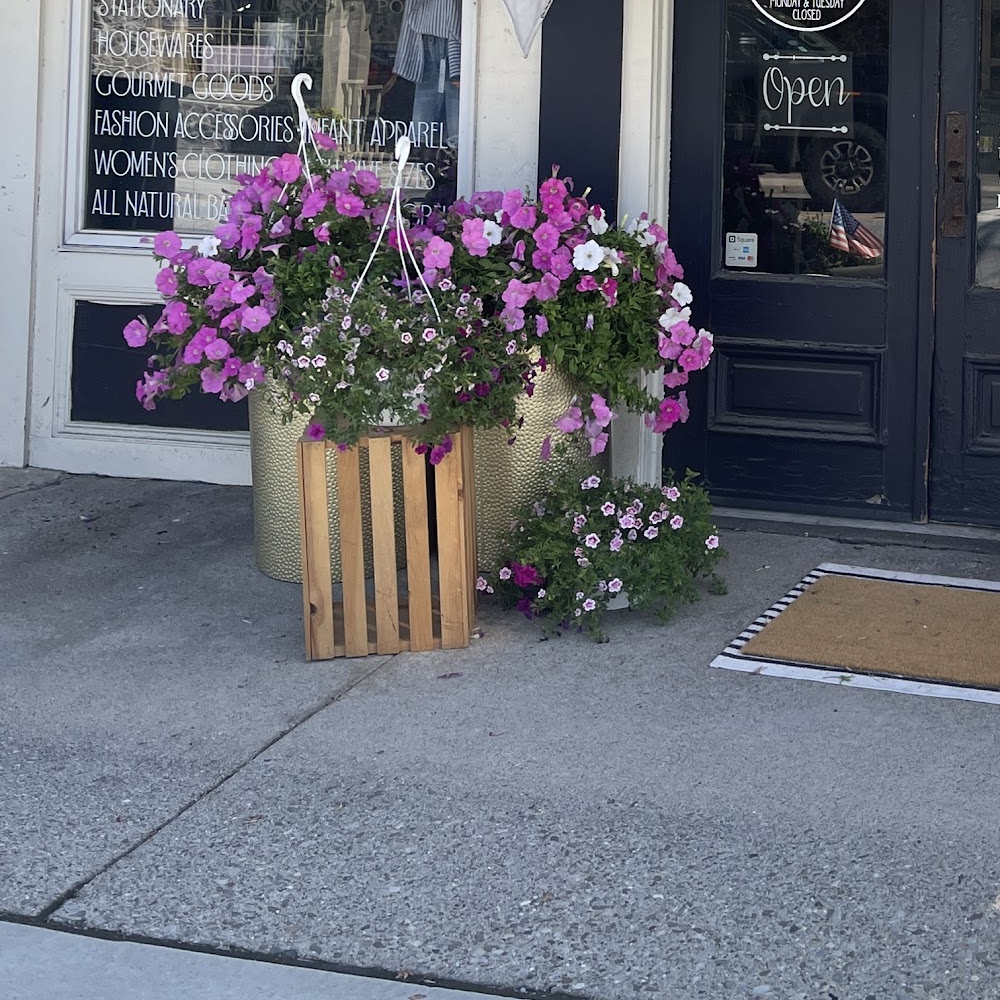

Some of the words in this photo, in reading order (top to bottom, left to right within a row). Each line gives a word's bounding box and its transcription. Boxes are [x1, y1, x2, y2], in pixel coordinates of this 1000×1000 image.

[792, 9, 822, 21] CLOSED
[97, 30, 214, 59] HOUSEWARES
[95, 70, 188, 99] GOURMET
[192, 73, 275, 102] GOODS
[763, 66, 850, 124] Open
[94, 109, 169, 138] FASHION
[173, 112, 294, 143] ACCESSORIES
[94, 149, 179, 179] WOMEN'S
[91, 189, 120, 217] ALL
[125, 191, 202, 219] NATURAL
